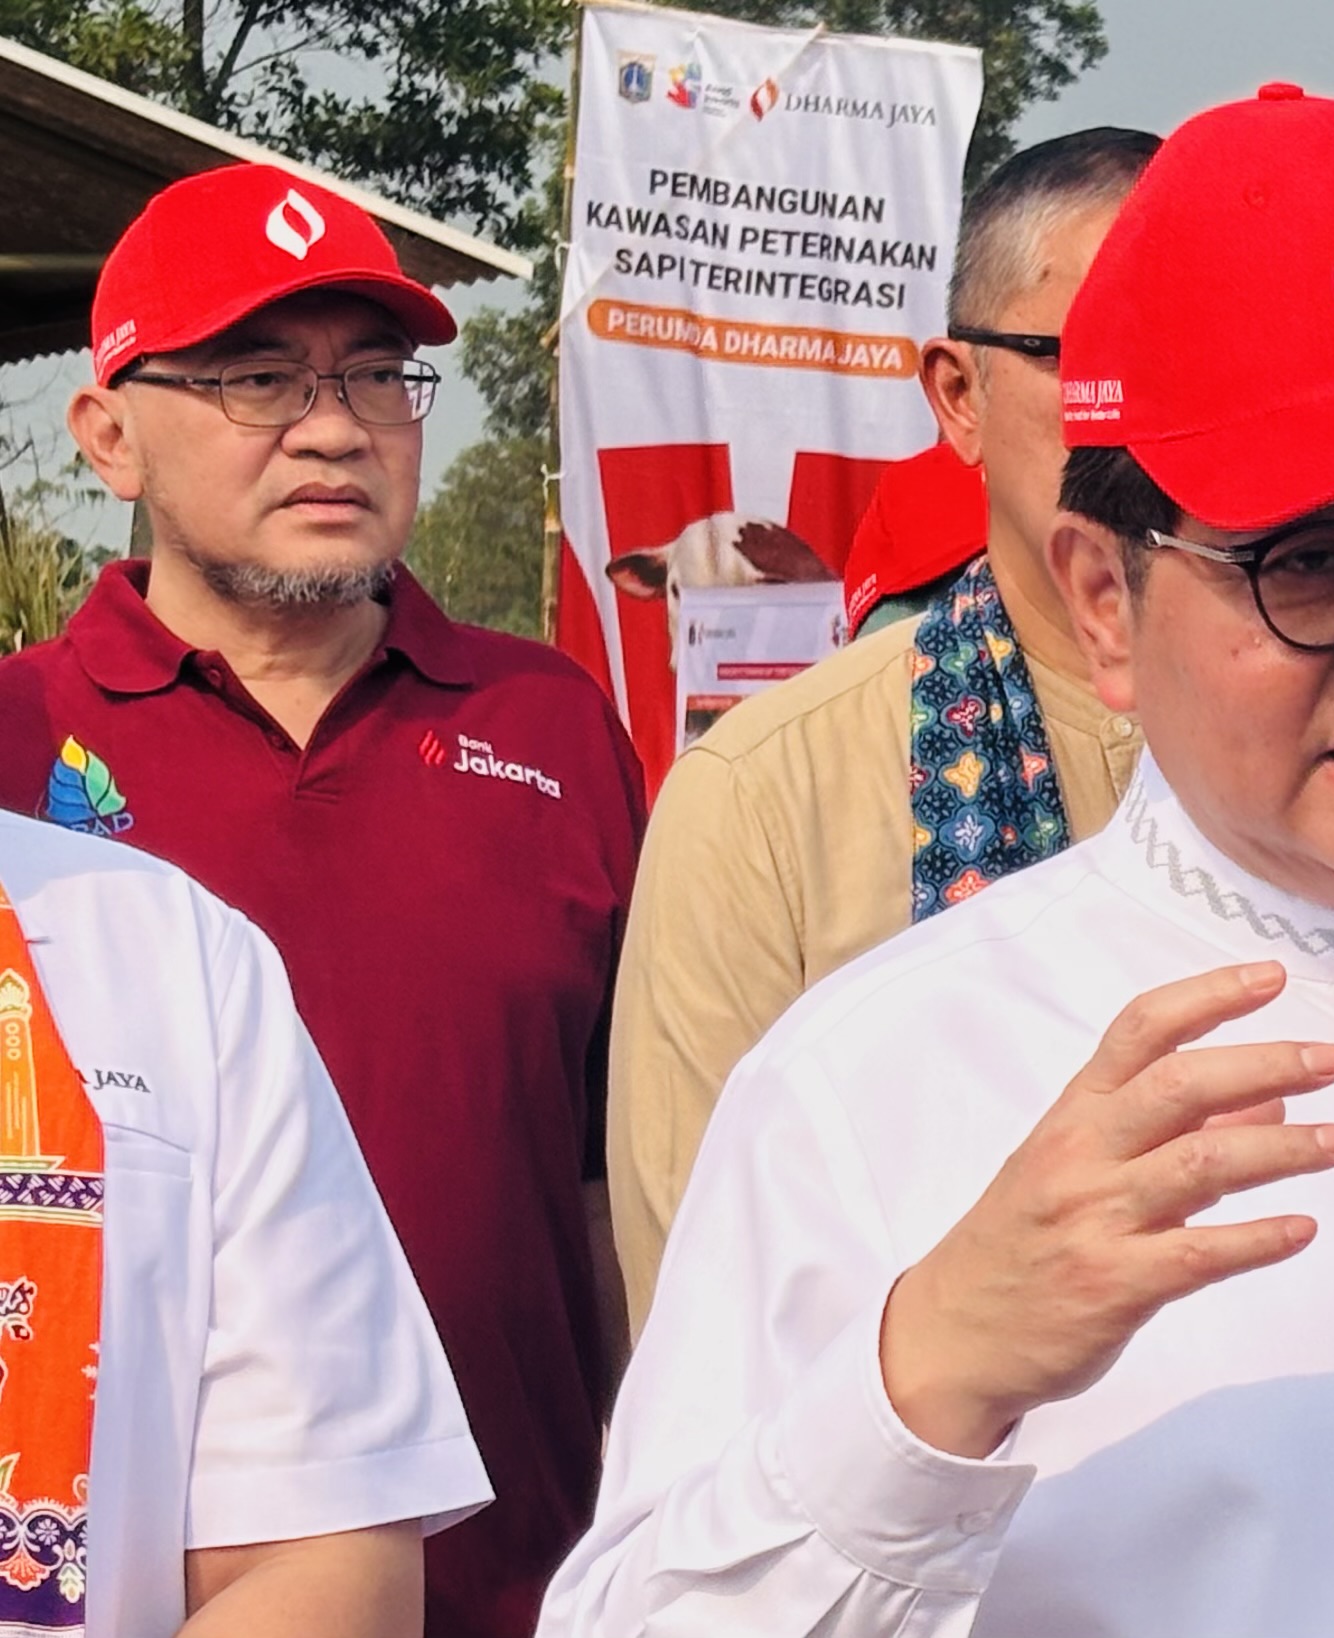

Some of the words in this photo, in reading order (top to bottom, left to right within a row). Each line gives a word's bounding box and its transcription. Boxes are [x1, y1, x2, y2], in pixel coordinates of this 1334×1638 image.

[784, 93, 884, 120] DHARMA
[885, 103, 937, 128] JAYA
[649, 168, 885, 224] PEMBANGUNAN
[586, 200, 730, 250] KAWASAN
[738, 226, 938, 272] PETERNAKAN
[688, 259, 907, 310] TERINTEGRASI
[724, 329, 837, 365] DHARMA
[837, 342, 902, 369] JAYA
[457, 734, 494, 753] Bank
[454, 749, 562, 799] Jakarta
[93, 1068, 152, 1093] JAYA
